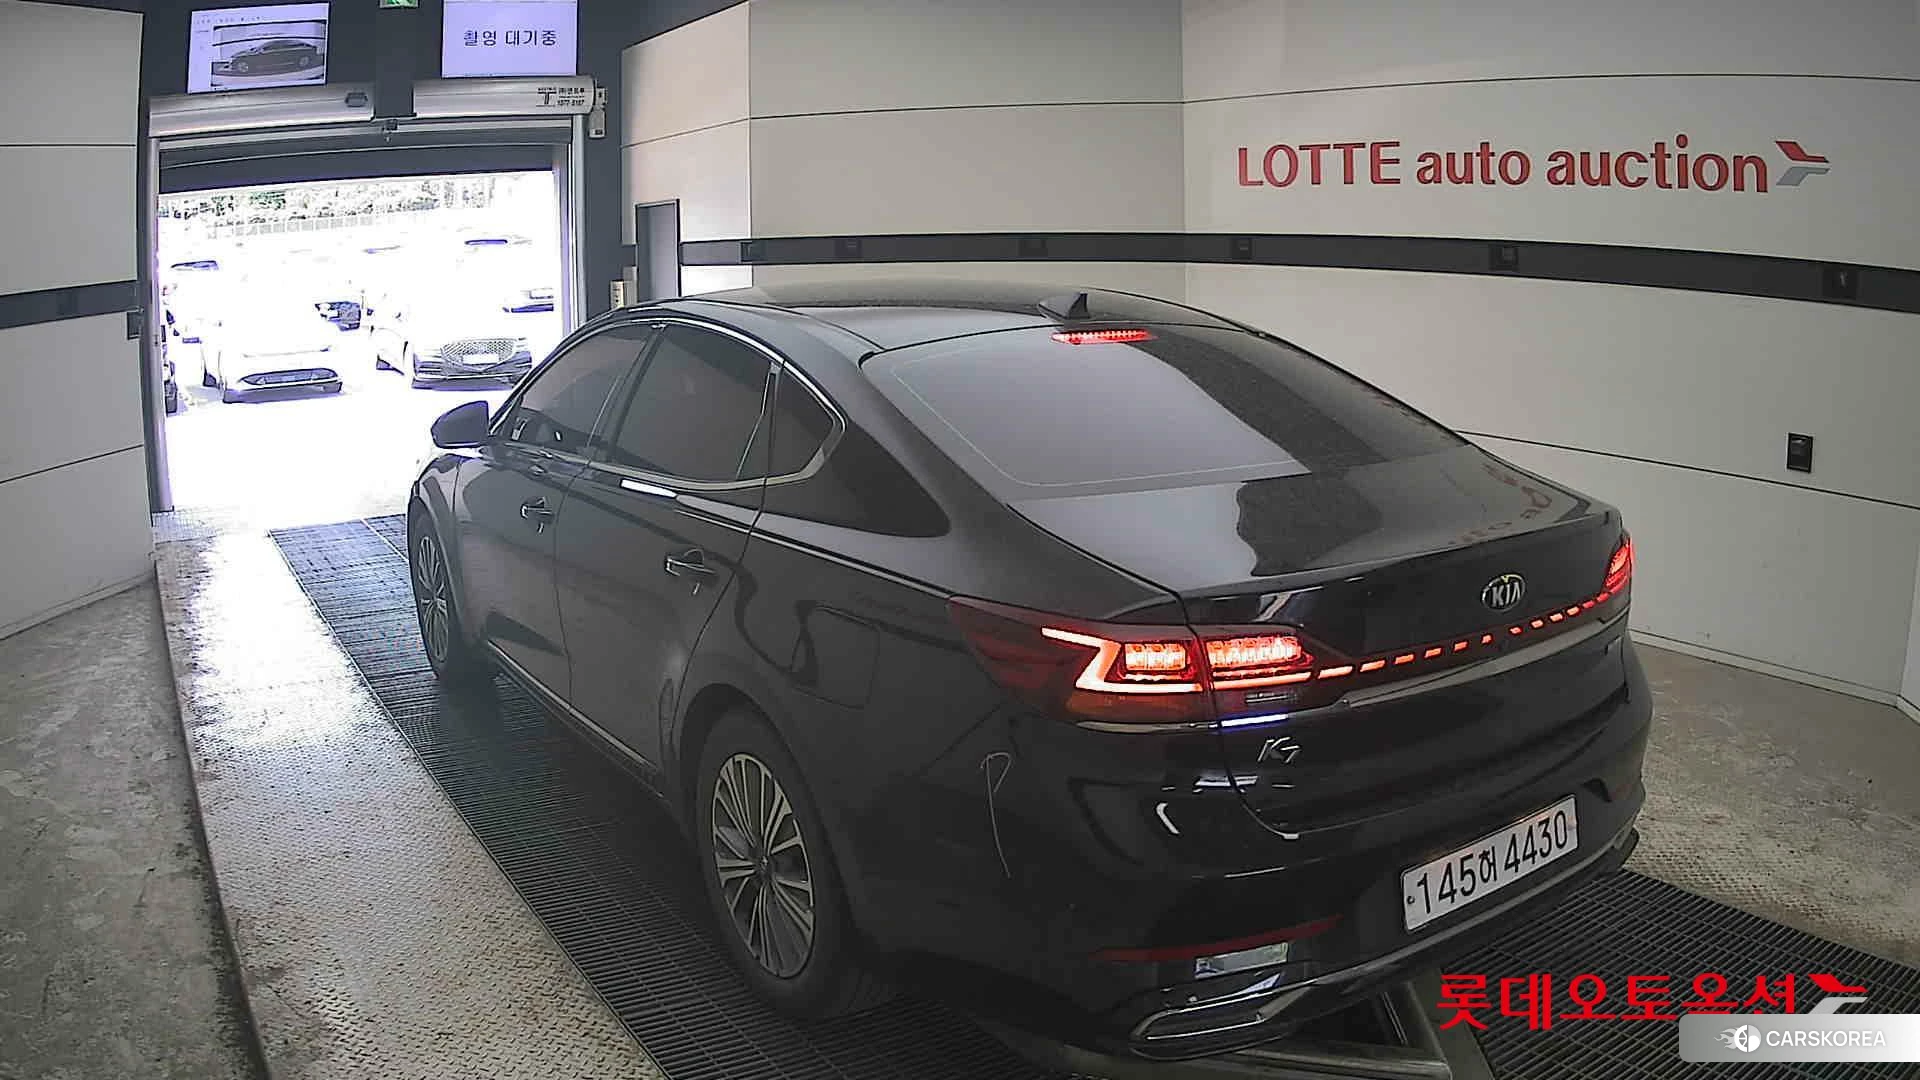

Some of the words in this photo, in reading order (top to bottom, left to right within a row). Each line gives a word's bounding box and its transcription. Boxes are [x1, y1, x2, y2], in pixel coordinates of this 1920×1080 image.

[504, 29, 557, 47] 대기중
[1237, 140, 1401, 188] LOTTE
[1415, 140, 1531, 186] auto
[1546, 134, 1769, 193] auction
[1490, 579, 1522, 608] KIA
[1257, 735, 1302, 764] K7
